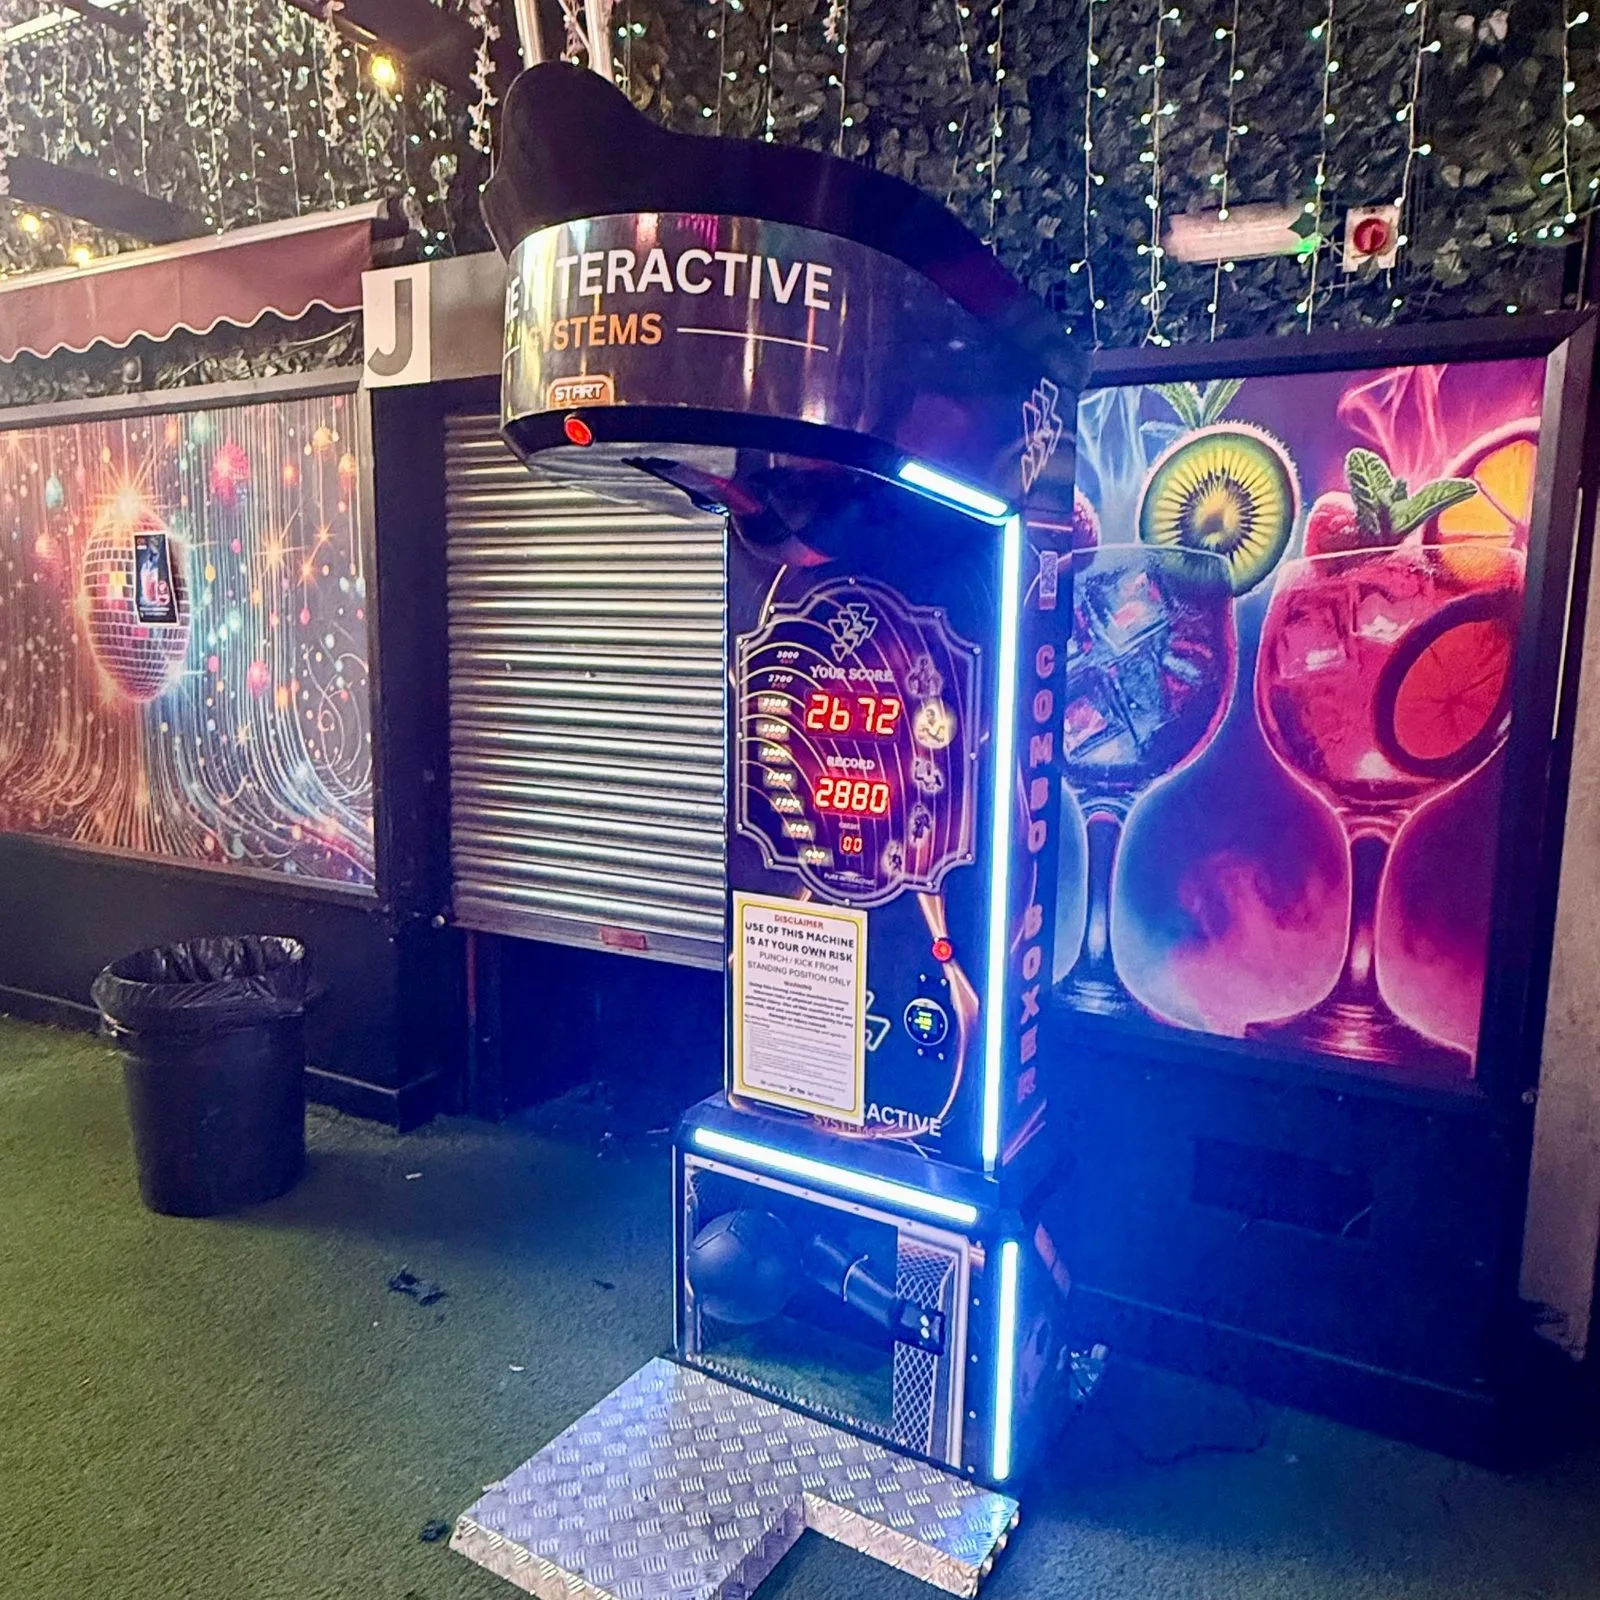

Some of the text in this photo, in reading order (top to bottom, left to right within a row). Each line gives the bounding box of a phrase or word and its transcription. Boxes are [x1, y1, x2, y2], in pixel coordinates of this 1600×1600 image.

[367, 278, 413, 377] J
[554, 382, 606, 401] START
[809, 664, 895, 682] YOUR SCORE
[826, 755, 876, 771] RECORD
[815, 777, 889, 814] 2880
[842, 835, 863, 853] 00
[774, 914, 824, 930] DISCLAIMER
[745, 922, 855, 948] USE OF THIS MACHINE
[746, 936, 853, 962] IS AT YOUR OWN RISK
[747, 961, 851, 987] STANDING POSITION ONLY
[759, 951, 789, 963] PUNCH
[794, 958, 813, 968] KICK
[815, 960, 839, 973] FROM
[865, 1103, 942, 1138] ACTIVE
